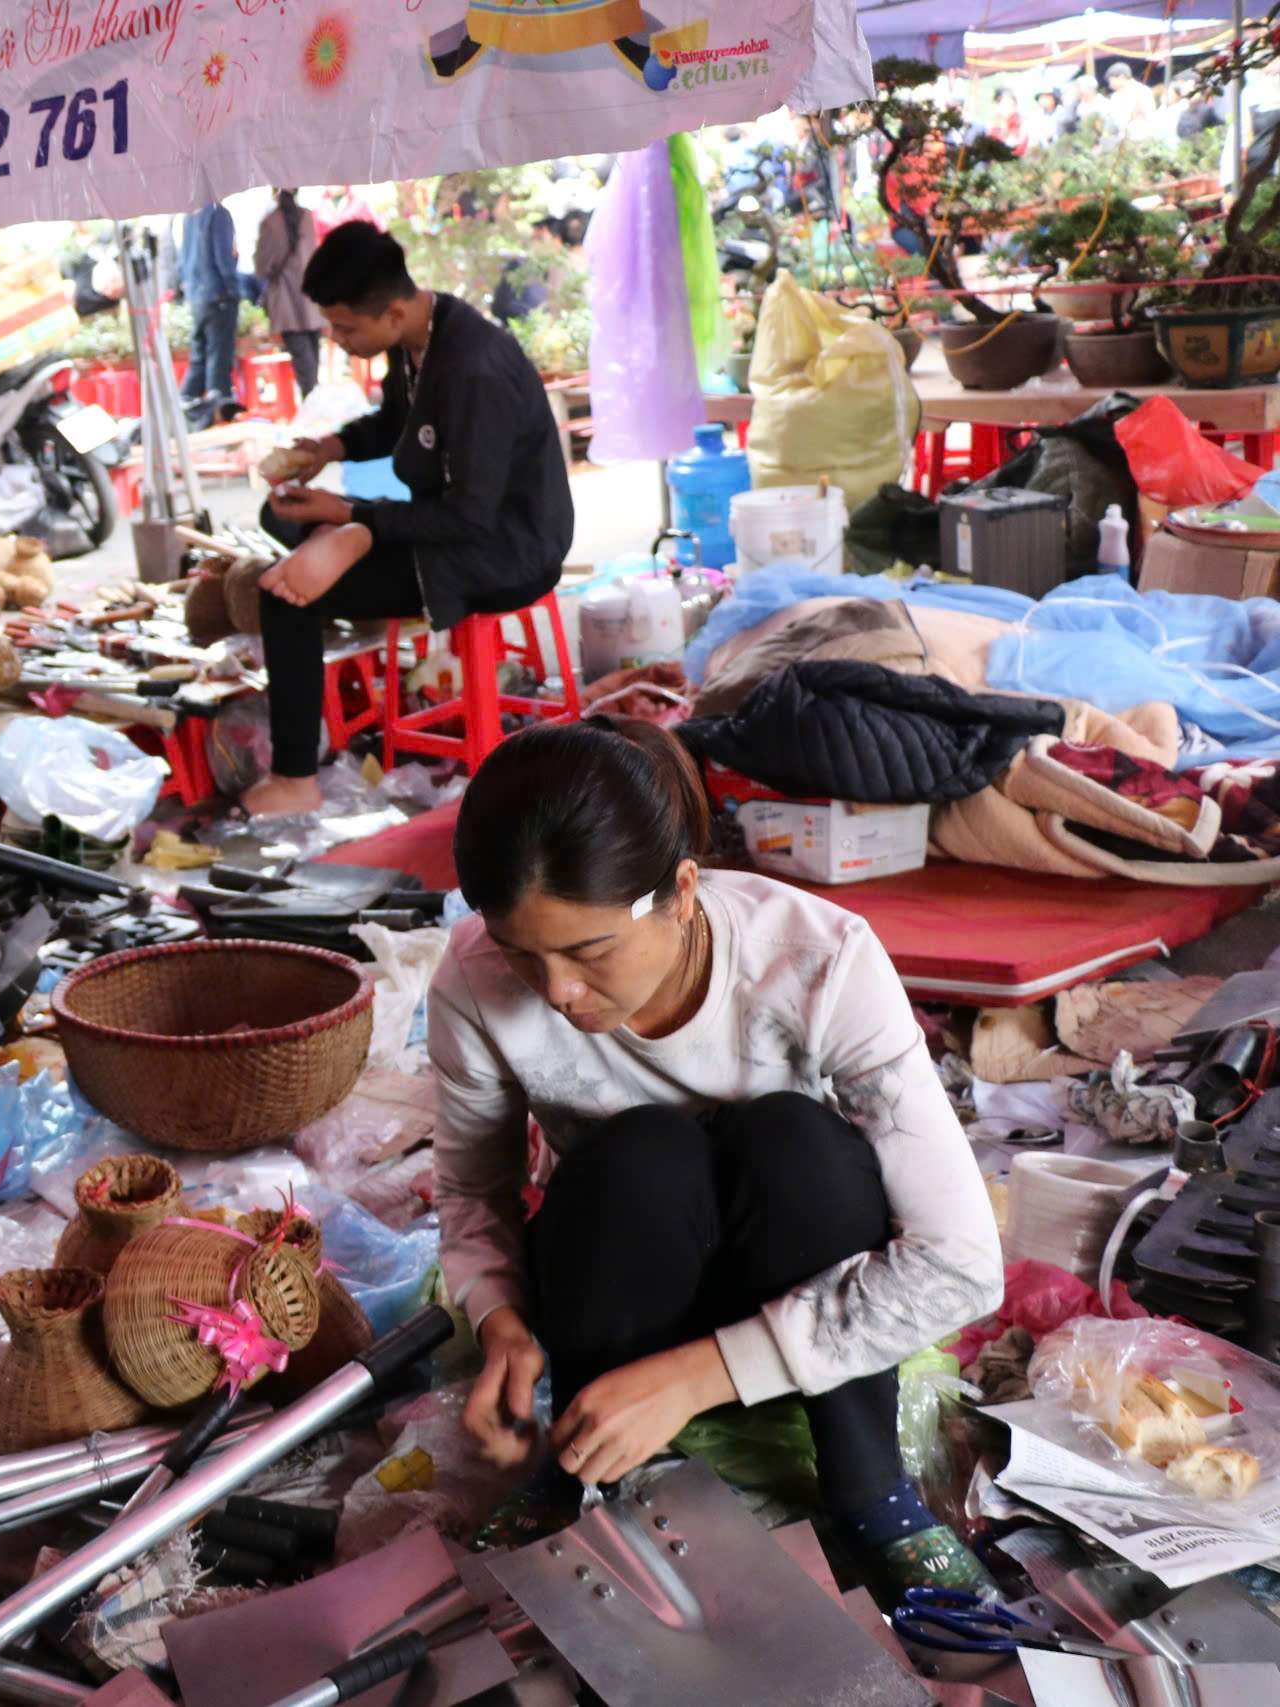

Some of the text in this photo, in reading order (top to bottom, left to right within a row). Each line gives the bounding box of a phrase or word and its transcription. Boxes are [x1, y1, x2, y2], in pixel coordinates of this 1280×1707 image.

[85, 0, 184, 65] khang
[29, 78, 128, 168] 761
[923, 1555, 950, 1573] VIP
